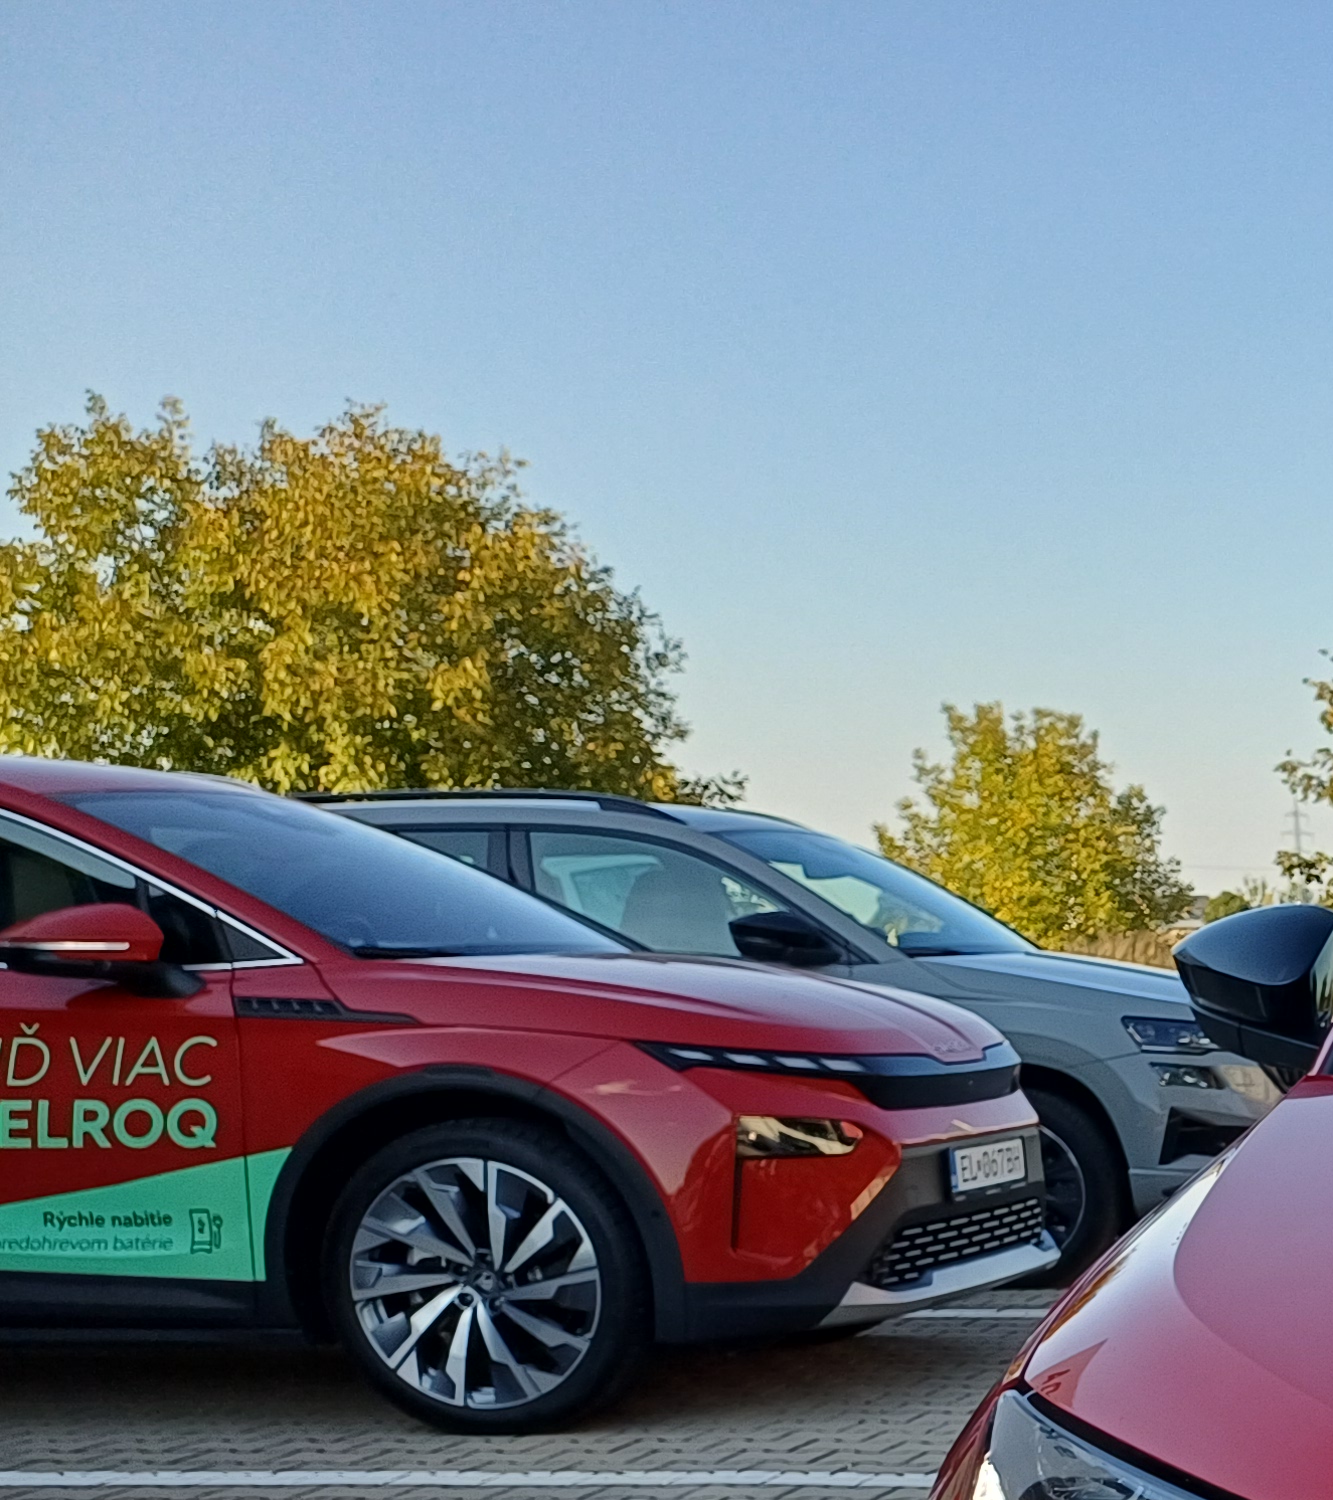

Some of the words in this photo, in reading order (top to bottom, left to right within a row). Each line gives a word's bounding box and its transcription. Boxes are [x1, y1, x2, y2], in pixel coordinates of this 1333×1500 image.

[0, 1022, 50, 1087] Ď
[69, 1035, 218, 1087] VIAC
[0, 1098, 218, 1149] ELROQ
[43, 1211, 105, 1231] Rýchle
[111, 1211, 173, 1228] nabitie
[0, 1235, 108, 1251] redohrevom
[113, 1234, 173, 1251] batérie
